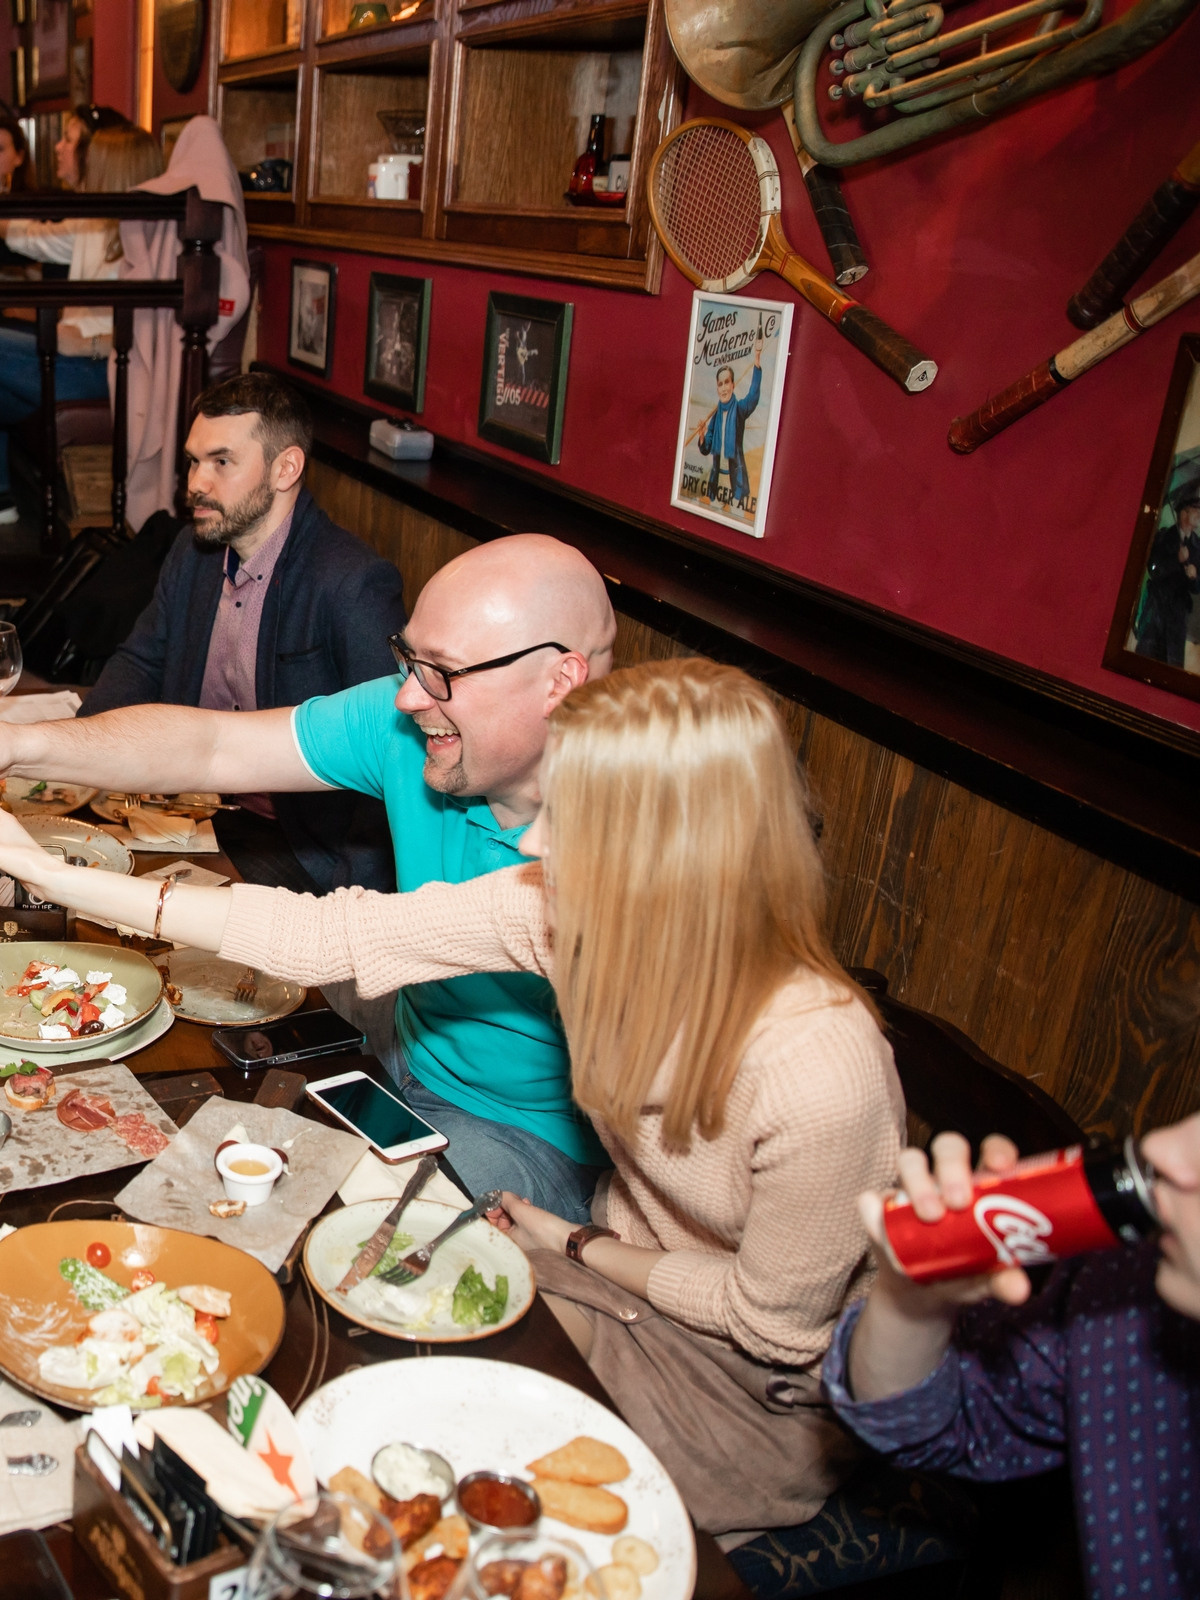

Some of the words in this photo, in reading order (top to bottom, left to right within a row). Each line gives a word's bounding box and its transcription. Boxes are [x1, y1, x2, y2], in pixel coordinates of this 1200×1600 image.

[697, 311, 738, 342] James
[694, 329, 749, 366] Mulhern
[496, 333, 509, 406] VERTIGO
[682, 473, 700, 493] DRY
[736, 494, 757, 514] ALE
